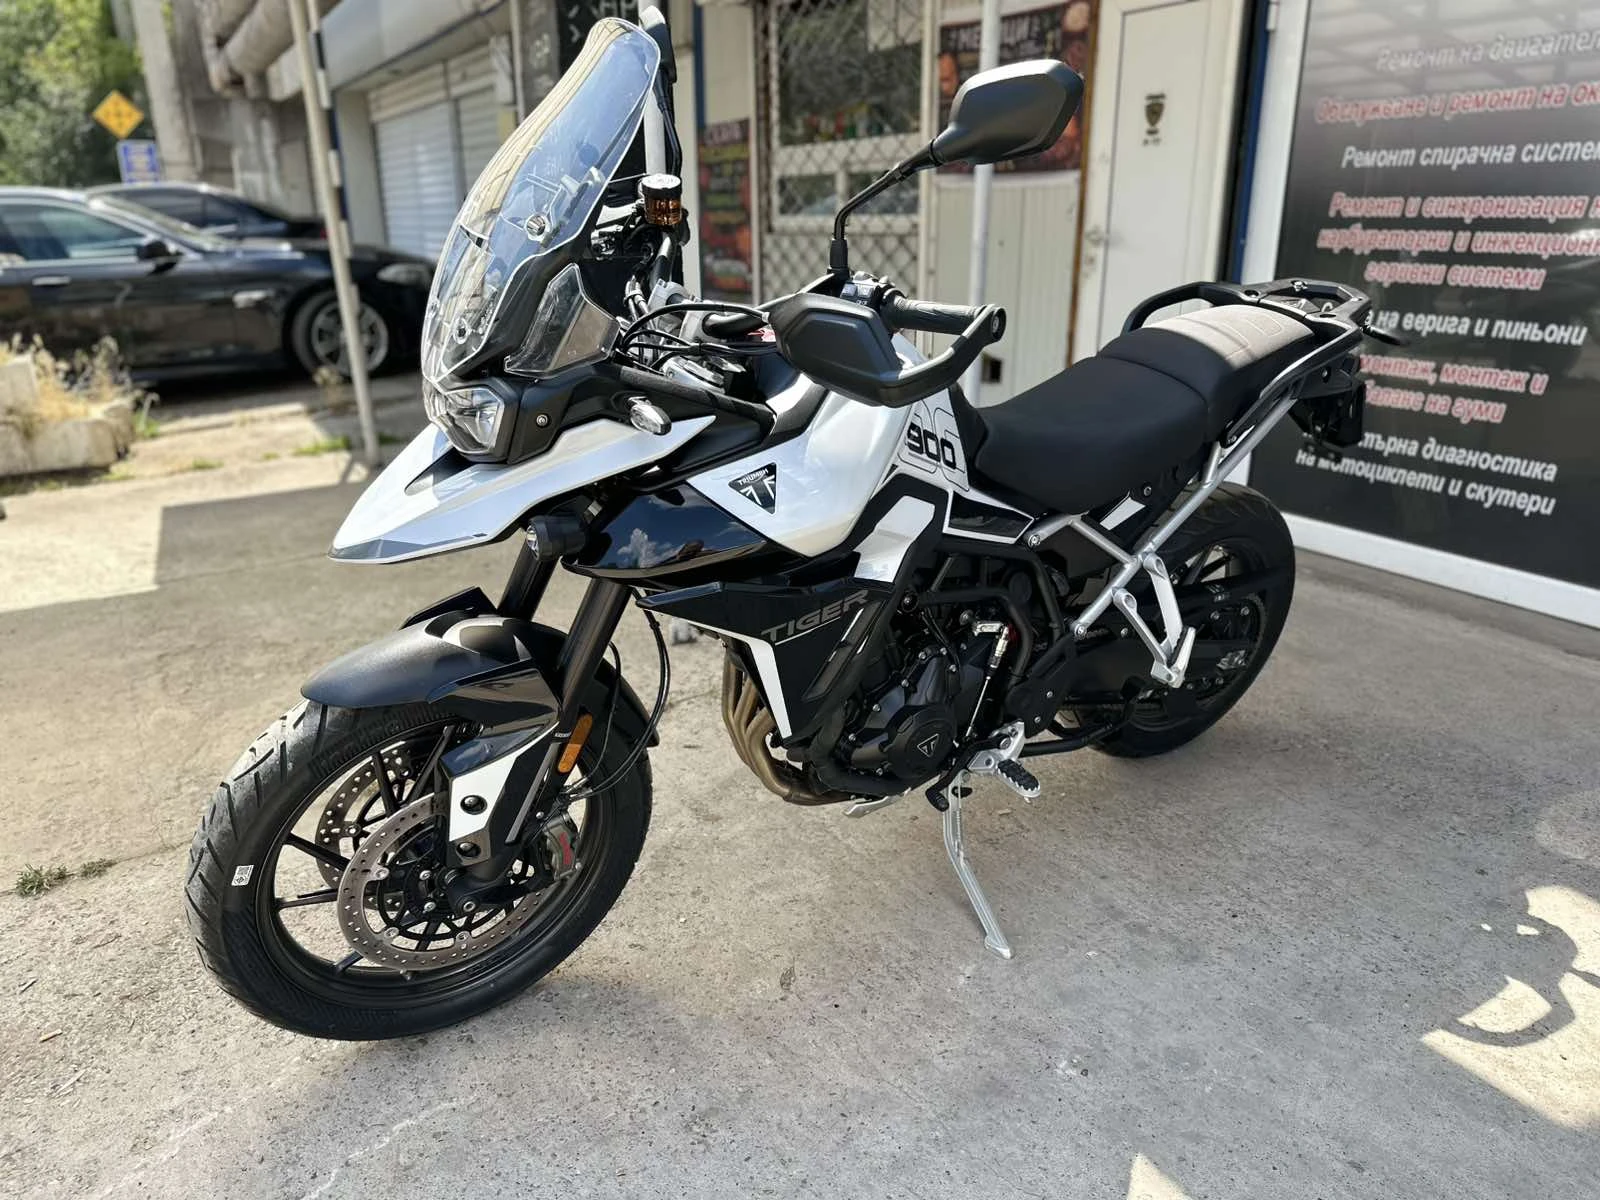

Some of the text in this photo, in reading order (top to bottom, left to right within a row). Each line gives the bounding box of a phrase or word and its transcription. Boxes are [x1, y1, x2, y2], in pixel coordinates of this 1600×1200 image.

[1376, 47, 1455, 72] Ремонт
[1459, 42, 1483, 64] на
[1429, 93, 1447, 117] и
[1444, 85, 1537, 121] ремонт
[1536, 82, 1571, 108] на
[1341, 146, 1416, 168] Ремонт
[1419, 144, 1516, 171] спирачна
[1328, 192, 1405, 218] Ремонт
[1404, 196, 1422, 218] и
[1421, 195, 1590, 224] синхронизация
[1316, 222, 1454, 256] карбураторни
[1453, 230, 1472, 254] и
[1363, 261, 1547, 291] горивни системи
[1376, 310, 1400, 329] на
[1402, 312, 1470, 337] верига
[1473, 318, 1489, 337] и
[1491, 320, 1588, 346] пиньони
[1360, 353, 1549, 396] монтаж, монтаж и
[1424, 393, 1453, 416] на
[1451, 396, 1507, 424] гуми
[907, 422, 956, 470] 900
[1358, 431, 1558, 482] търна диагностика
[739, 468, 769, 486] TRIUMPH
[1448, 477, 1463, 497] и
[1464, 481, 1557, 517] скутери
[761, 589, 869, 642] TIGER
